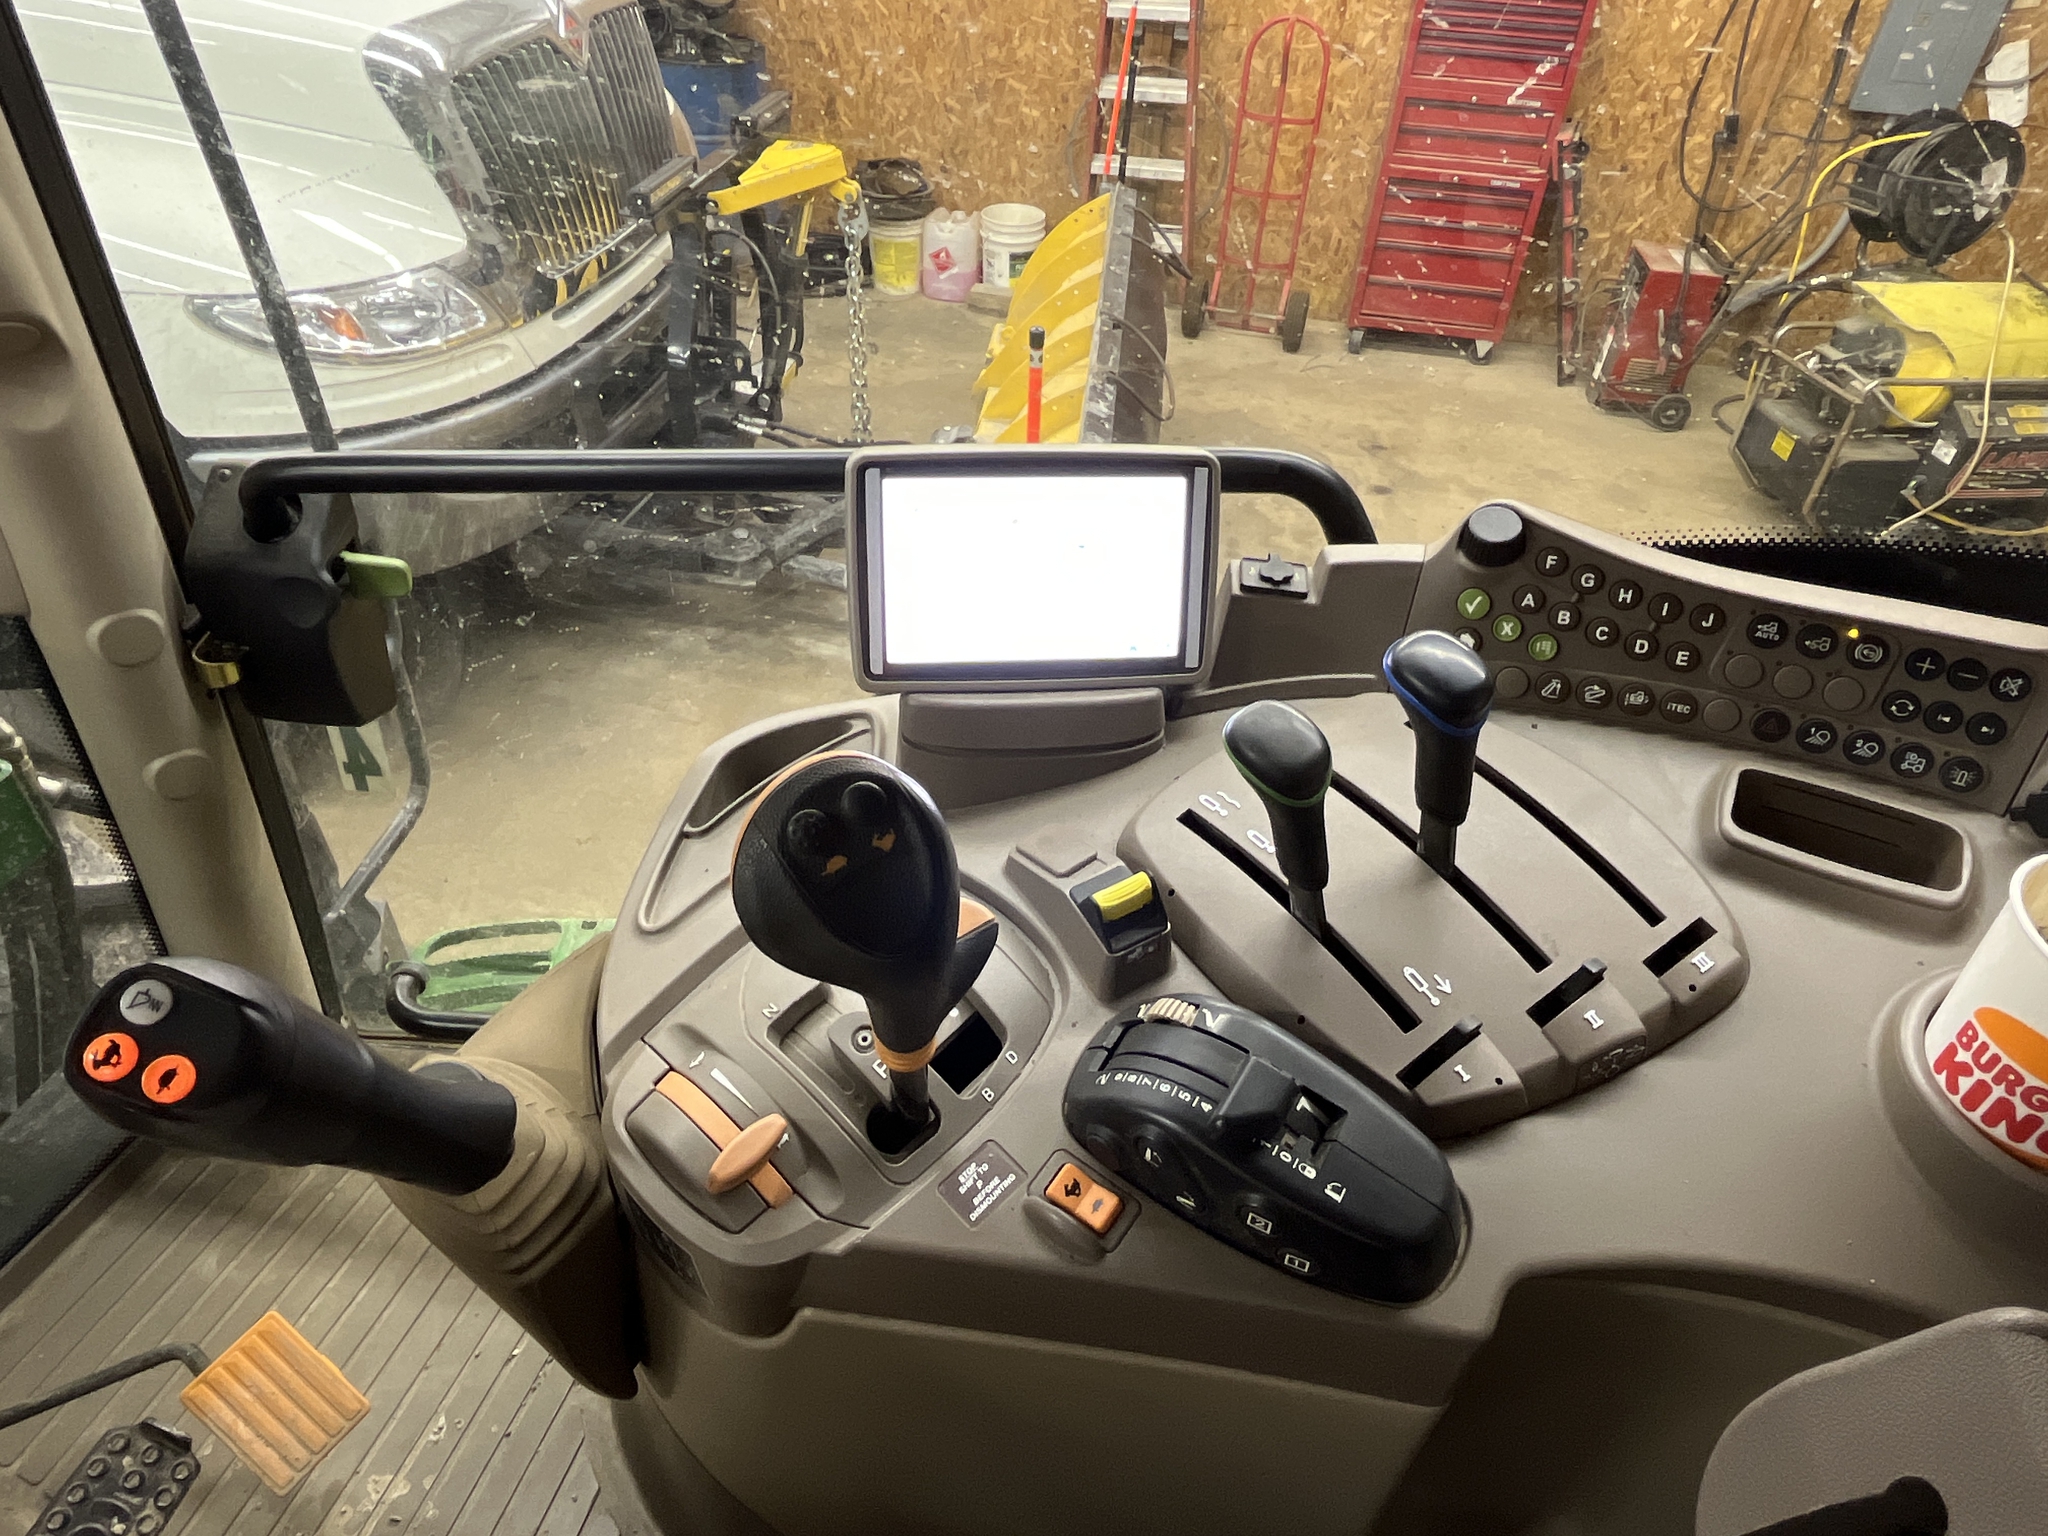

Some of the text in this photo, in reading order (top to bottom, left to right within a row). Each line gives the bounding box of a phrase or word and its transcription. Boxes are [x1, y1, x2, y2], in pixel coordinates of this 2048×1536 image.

[1546, 555, 1558, 570] F
[1581, 572, 1595, 588] G
[1521, 592, 1535, 608] A
[1618, 588, 1633, 604] H
[1662, 602, 1669, 616] I
[1557, 610, 1570, 625] B
[1701, 612, 1714, 628] J
[1595, 626, 1609, 641] C
[1755, 630, 1780, 641] AUTO
[1634, 639, 1649, 654] D
[1675, 650, 1690, 666] E
[1691, 951, 1715, 973] III
[762, 1003, 780, 1019] N
[1584, 1010, 1604, 1029] II
[1005, 1050, 1018, 1065] D
[981, 1087, 995, 1102] B
[958, 1162, 977, 1183] STOP
[959, 1163, 989, 1194] SHIFT TO
[972, 1175, 1001, 1206] BEFORE
[976, 1179, 983, 1190] P
[969, 1173, 1016, 1222] DISMOUNTING
